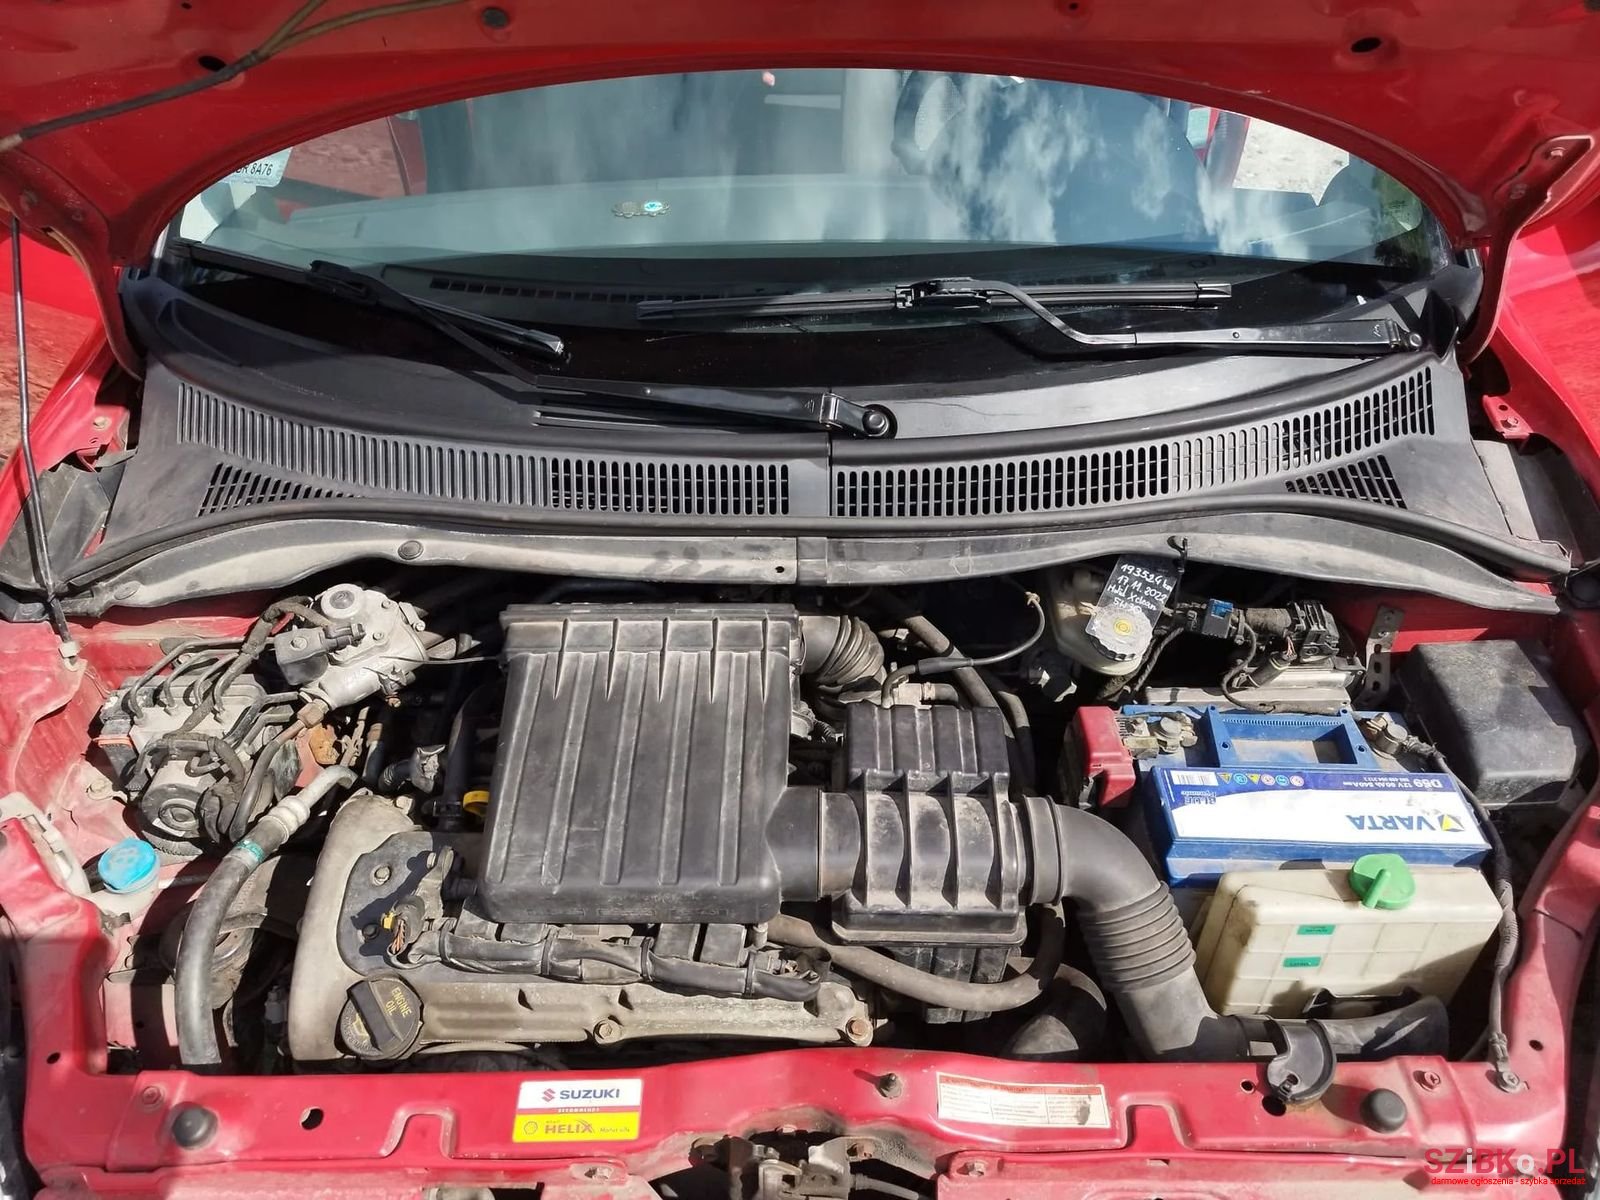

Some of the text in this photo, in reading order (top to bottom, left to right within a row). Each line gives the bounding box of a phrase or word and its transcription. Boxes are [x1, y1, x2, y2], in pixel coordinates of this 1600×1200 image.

[250, 162, 273, 176] 8A76
[1144, 586, 1168, 604] 2022
[1413, 778, 1444, 789] D59
[1346, 815, 1436, 831] VARTA
[385, 999, 398, 1017] OIL
[391, 986, 413, 1019] ENGINE
[560, 1088, 620, 1100] SUZUKI
[545, 1121, 593, 1134] HELIX
